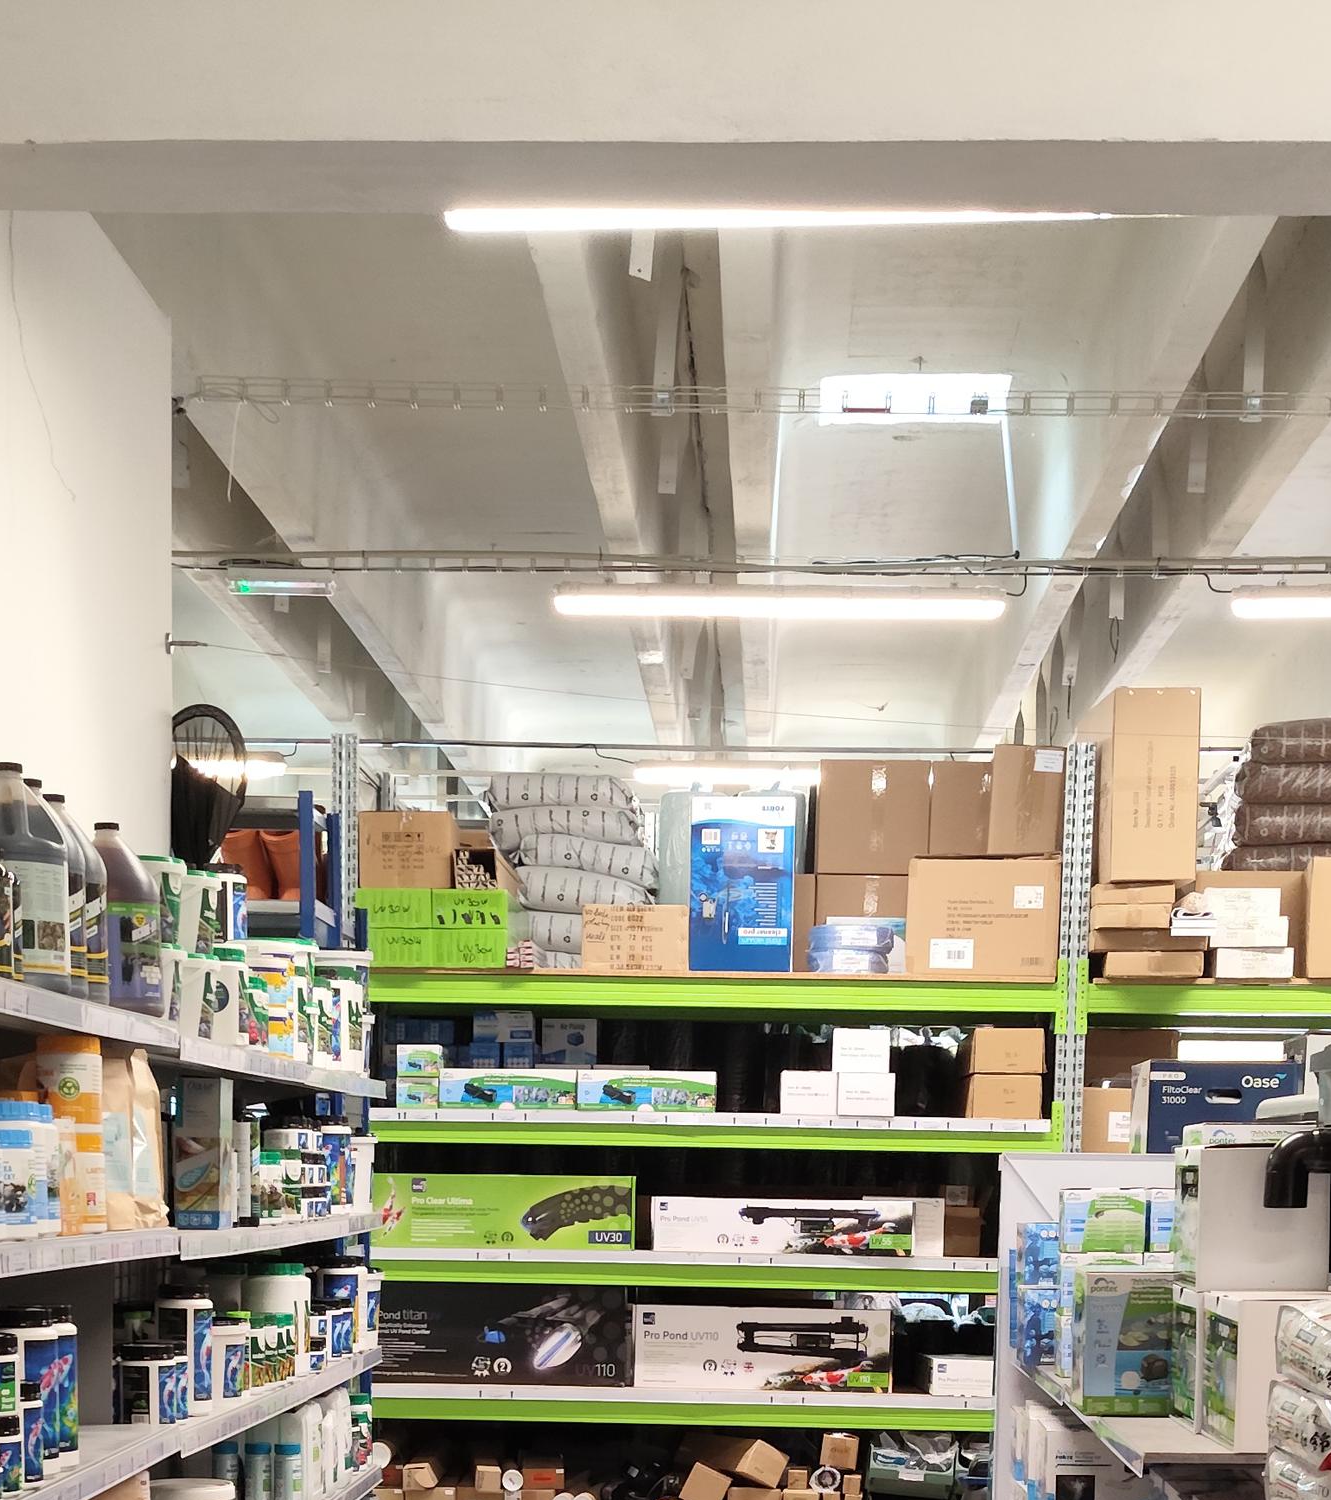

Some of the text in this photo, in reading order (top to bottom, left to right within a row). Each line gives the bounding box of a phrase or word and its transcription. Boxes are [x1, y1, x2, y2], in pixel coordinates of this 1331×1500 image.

[1241, 1075, 1281, 1089] Oase
[1162, 1086, 1203, 1095] FiltoClear
[1161, 1096, 1187, 1105] 31000
[412, 1196, 474, 1205] Pro Clear Ultima
[660, 1215, 672, 1224] Pro
[673, 1215, 691, 1224] Pond
[595, 1232, 623, 1243] UV30
[1091, 1285, 1119, 1295] pontec
[402, 1308, 428, 1320] titan
[644, 1330, 720, 1342] Pro Pond UV110
